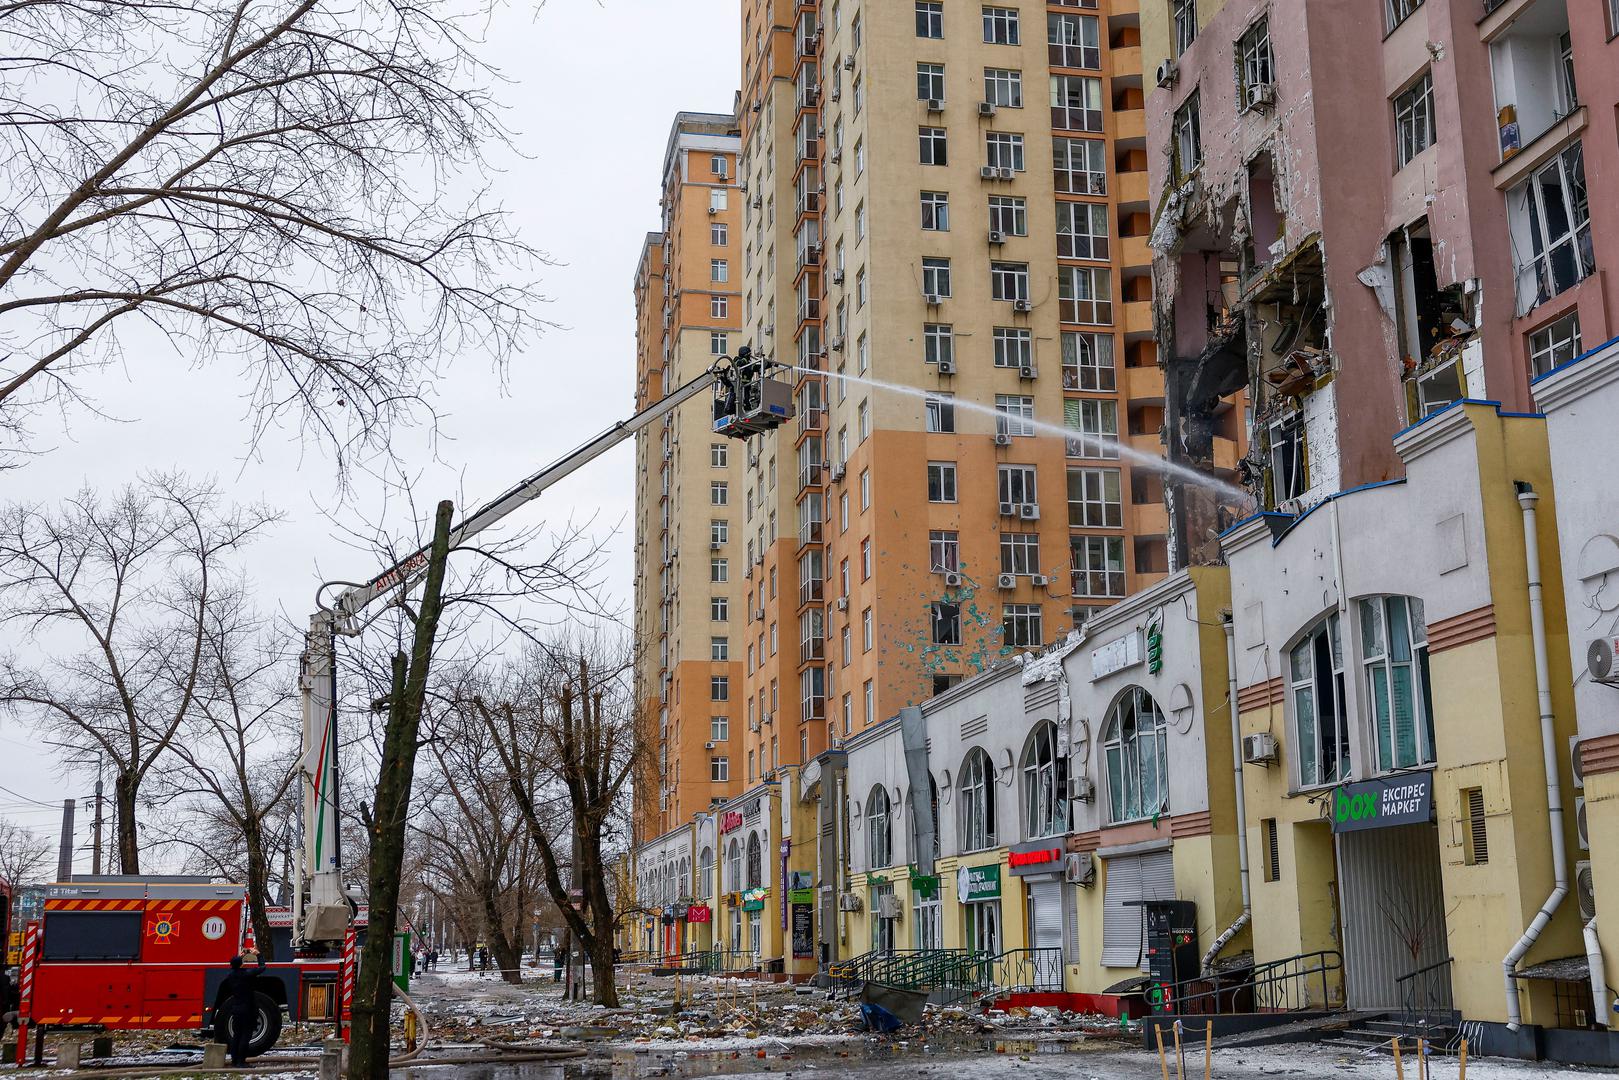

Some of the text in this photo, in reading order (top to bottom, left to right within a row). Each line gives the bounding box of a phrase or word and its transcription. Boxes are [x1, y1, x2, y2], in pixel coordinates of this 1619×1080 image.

[1382, 783, 1426, 802] ЕКСПРЕС
[1336, 784, 1377, 823] box
[1382, 798, 1421, 817] МАРКЕТ
[206, 922, 222, 934] 101
